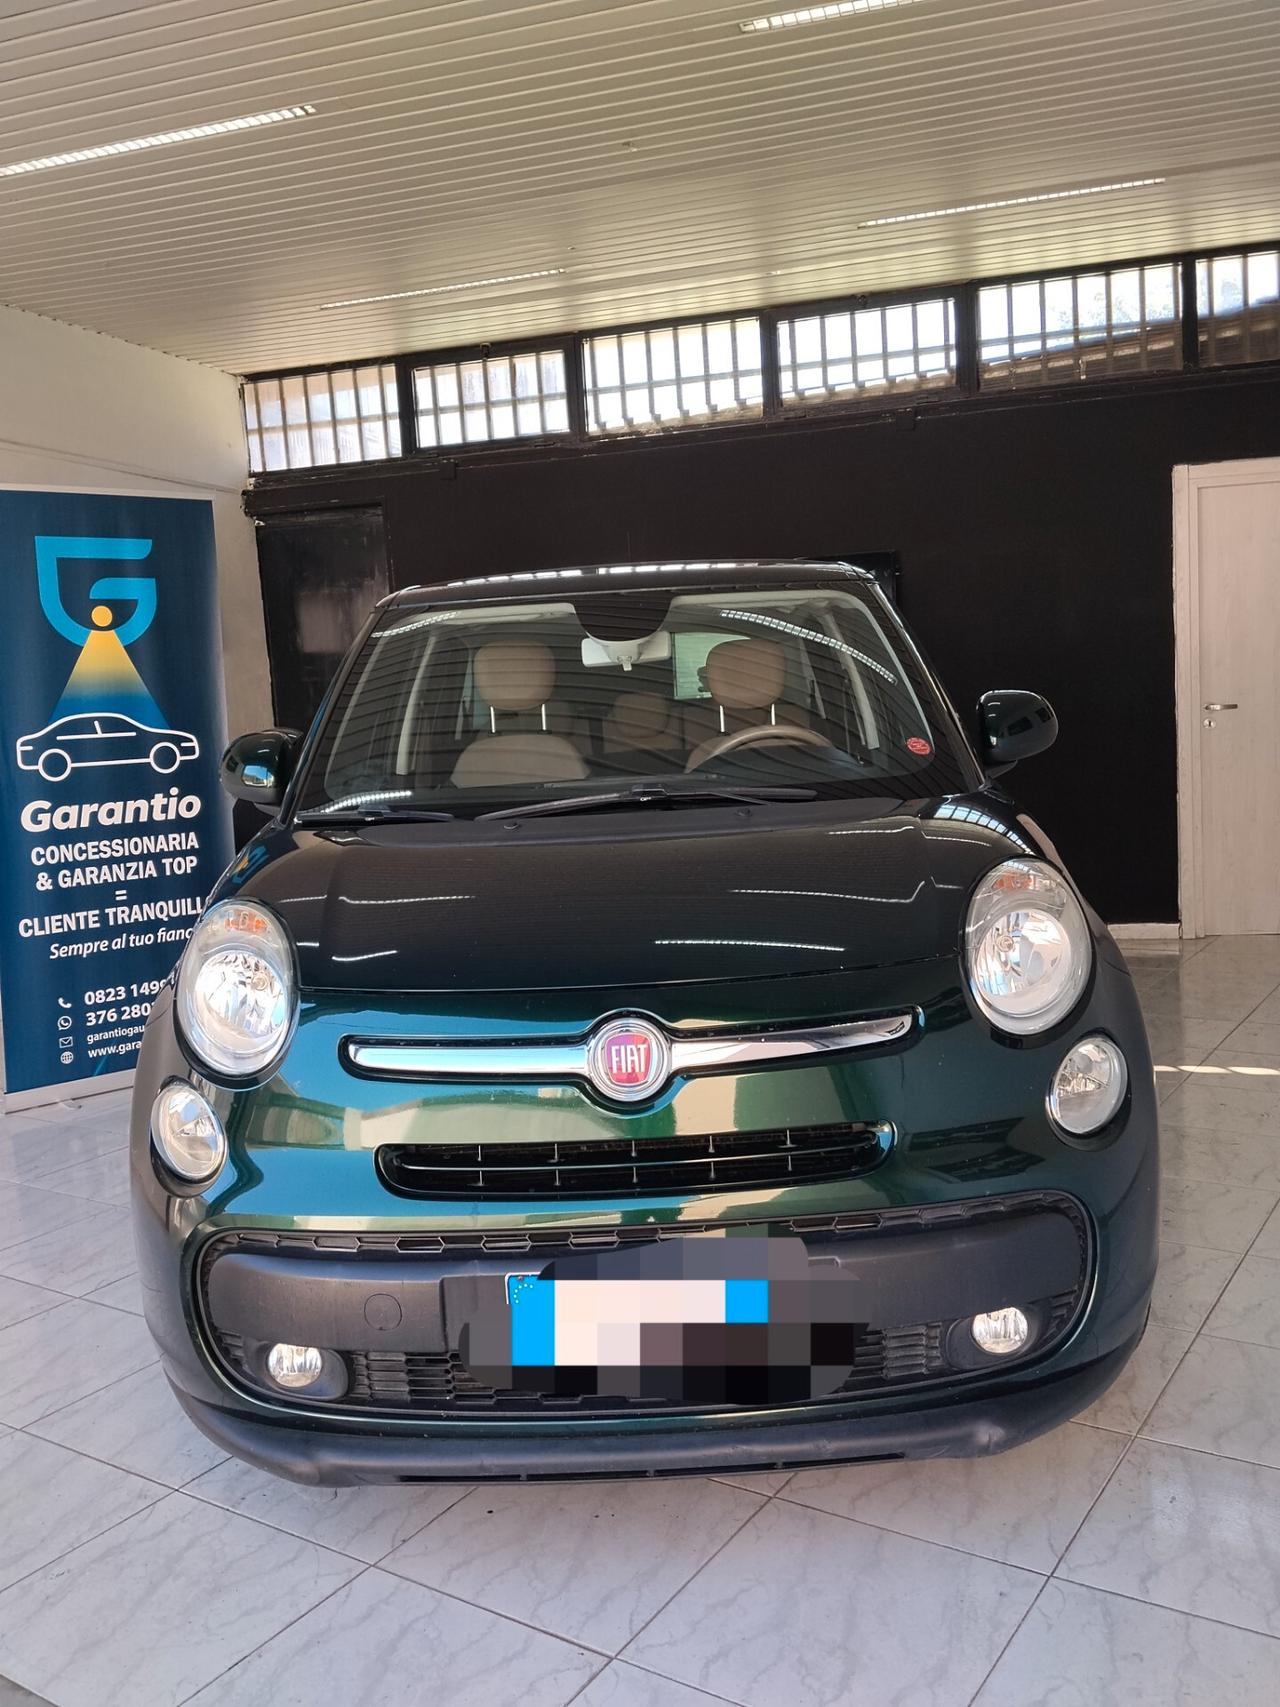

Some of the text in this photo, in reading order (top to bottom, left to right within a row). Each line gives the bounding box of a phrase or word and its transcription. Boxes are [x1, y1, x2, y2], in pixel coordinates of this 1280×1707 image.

[20, 787, 202, 833] Garantio
[31, 832, 199, 866] CONCESSIONARIA
[36, 856, 198, 891] & GARANZIA TOP
[18, 896, 203, 938] CLIENTE TRANQUILL
[50, 927, 194, 960] Sempre al tuo fianc
[84, 986, 126, 1005] 0823
[85, 1002, 155, 1026] 376 280
[86, 1025, 146, 1044] garantiogau
[88, 1041, 142, 1058] www.gara
[611, 1044, 648, 1074] FIAT
